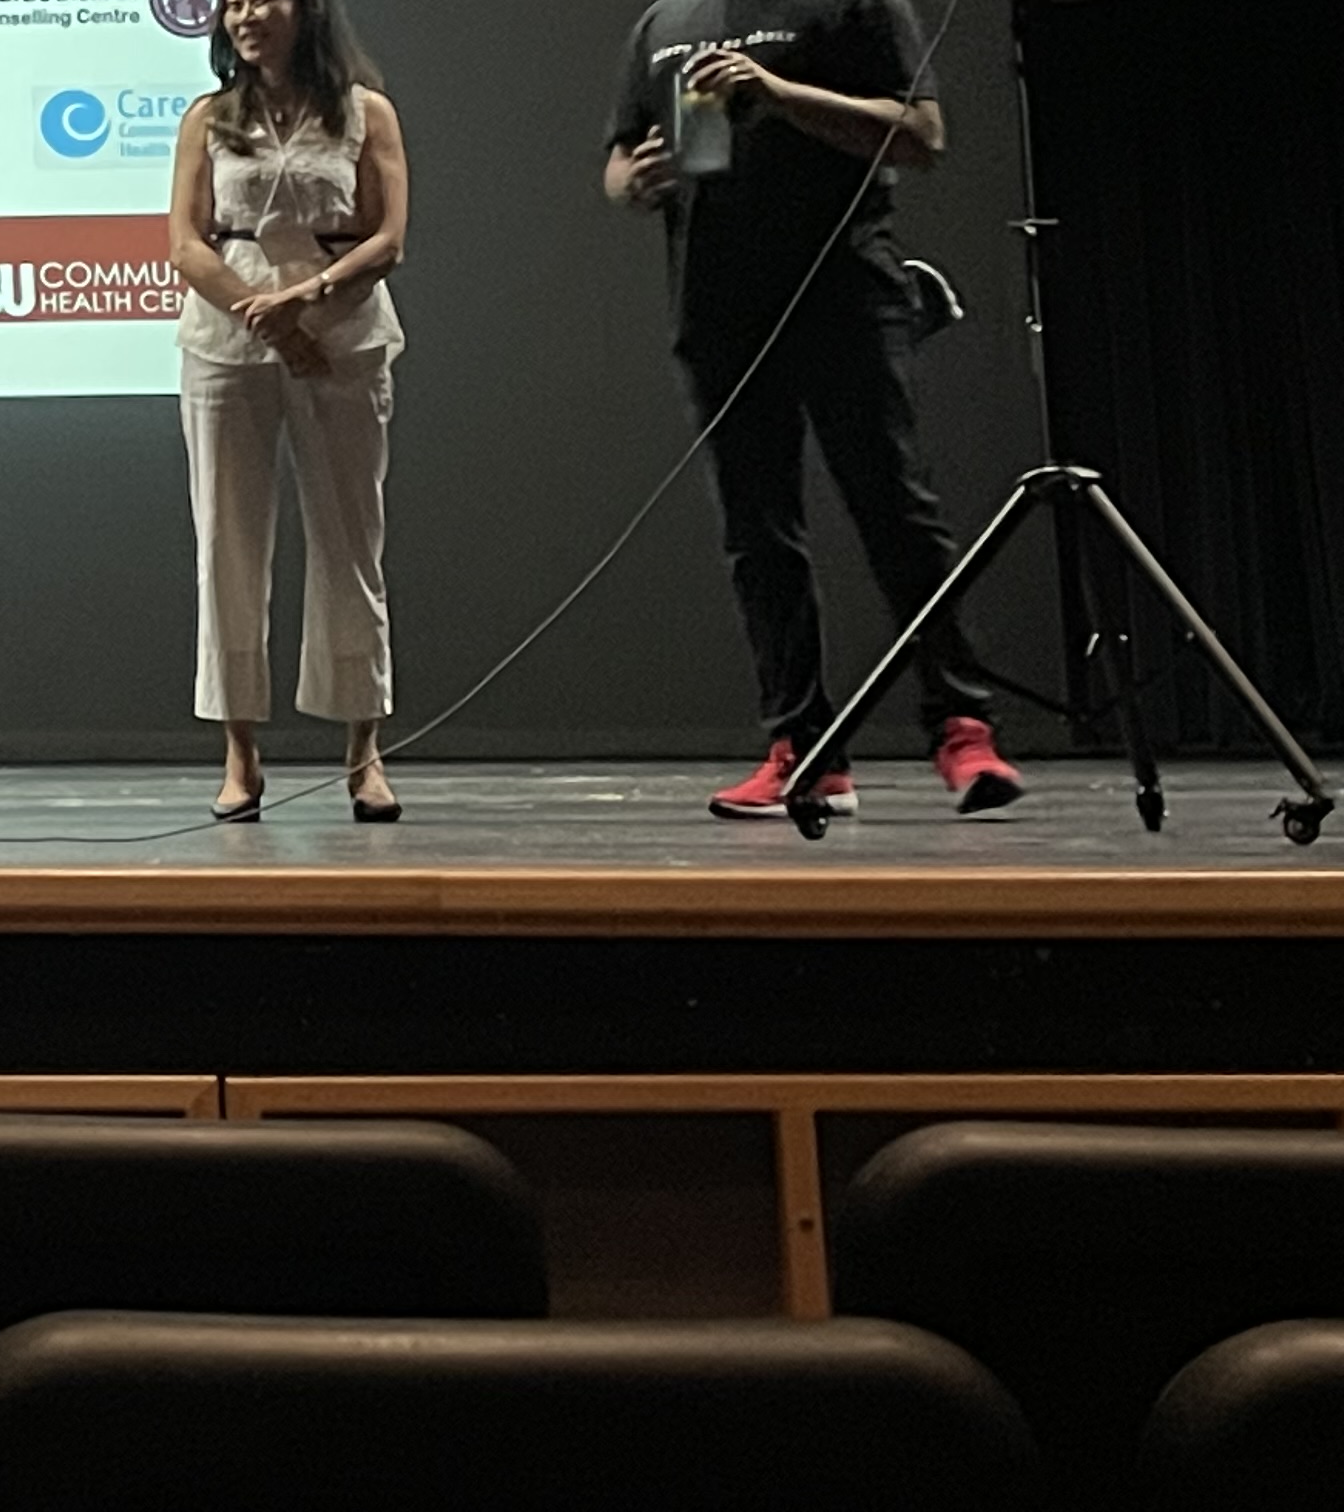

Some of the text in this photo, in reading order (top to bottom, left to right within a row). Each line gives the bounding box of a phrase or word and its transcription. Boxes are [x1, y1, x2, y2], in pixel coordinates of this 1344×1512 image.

[76, 8, 141, 24] Centre
[117, 89, 187, 118] Care
[39, 260, 179, 287] COMMU
[40, 289, 185, 314] HEALTH CEN
